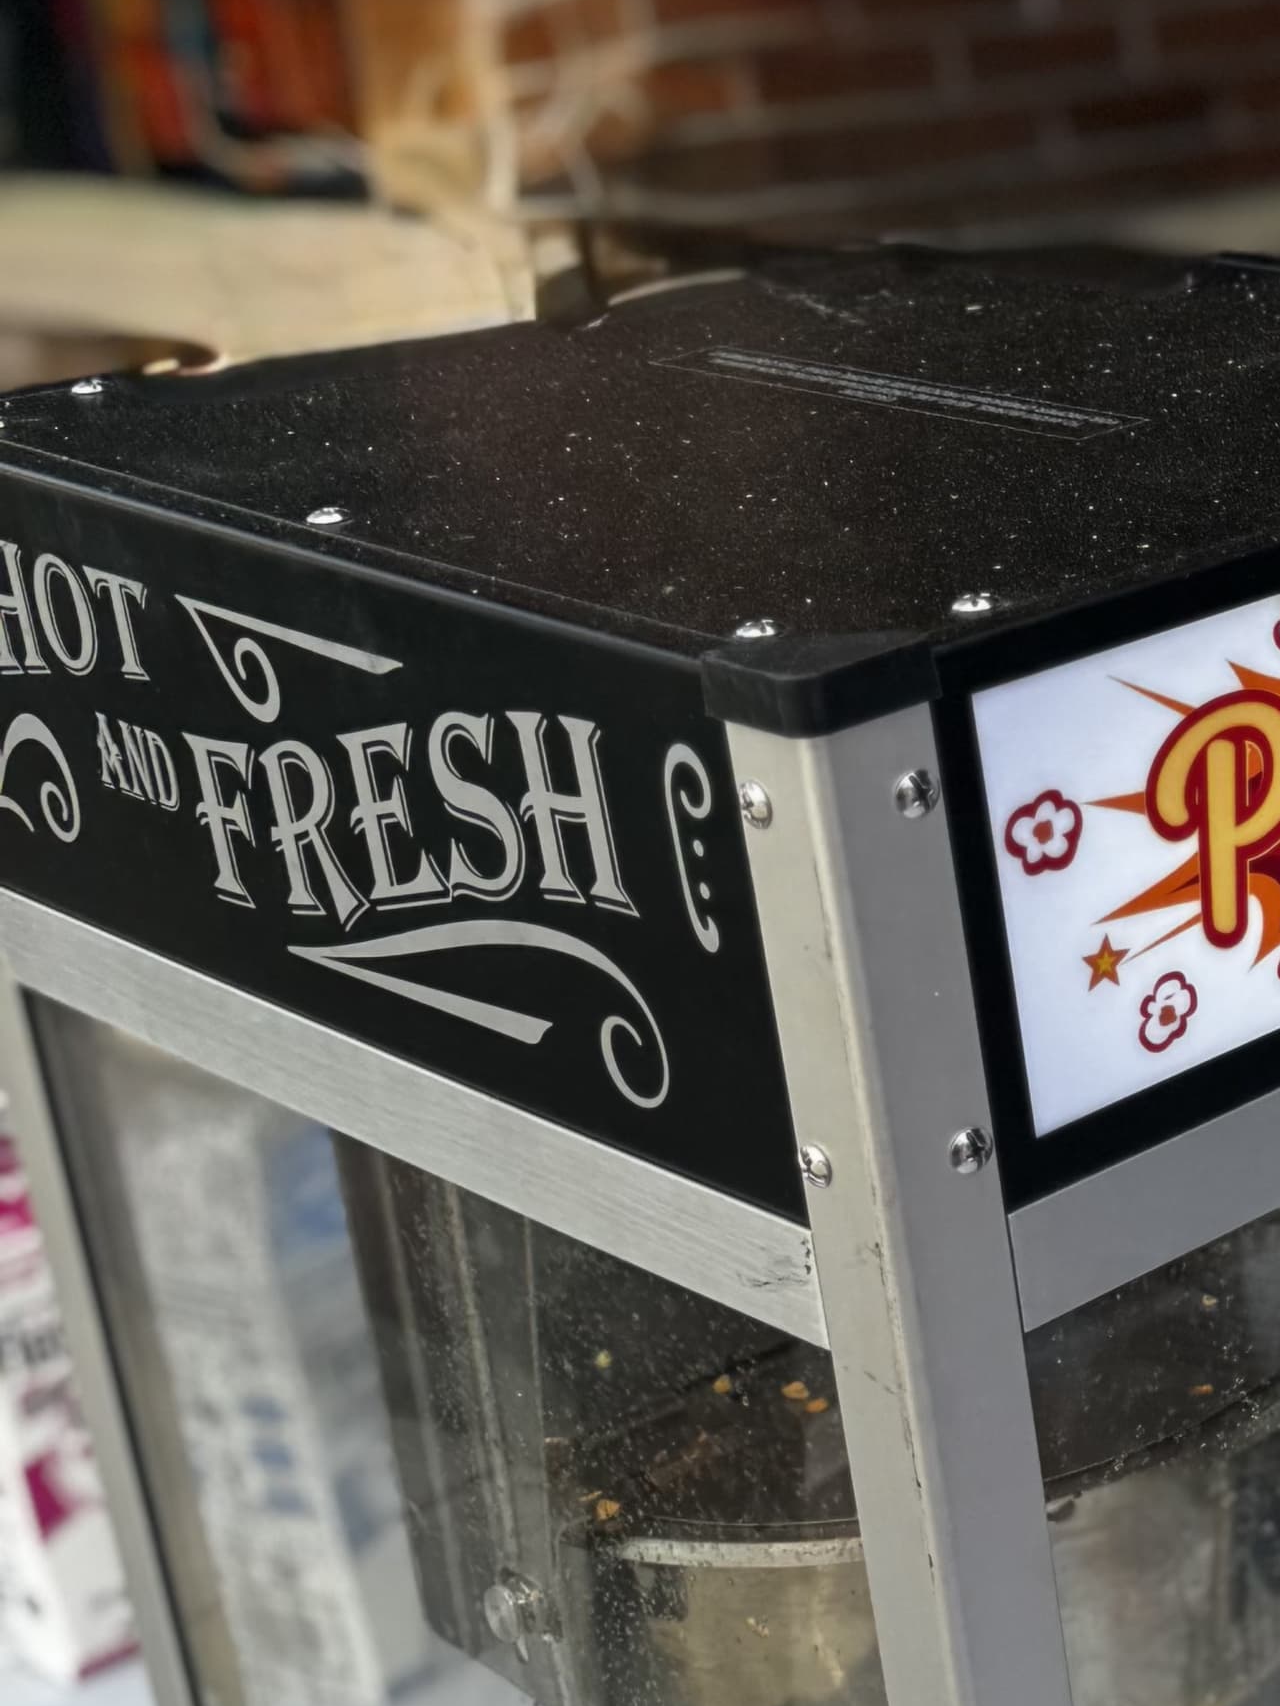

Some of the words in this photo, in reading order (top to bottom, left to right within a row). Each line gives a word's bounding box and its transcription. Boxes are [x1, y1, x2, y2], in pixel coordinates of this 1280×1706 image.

[0, 540, 151, 681] HOT
[95, 712, 180, 811] AND
[181, 712, 640, 932] FRESH
